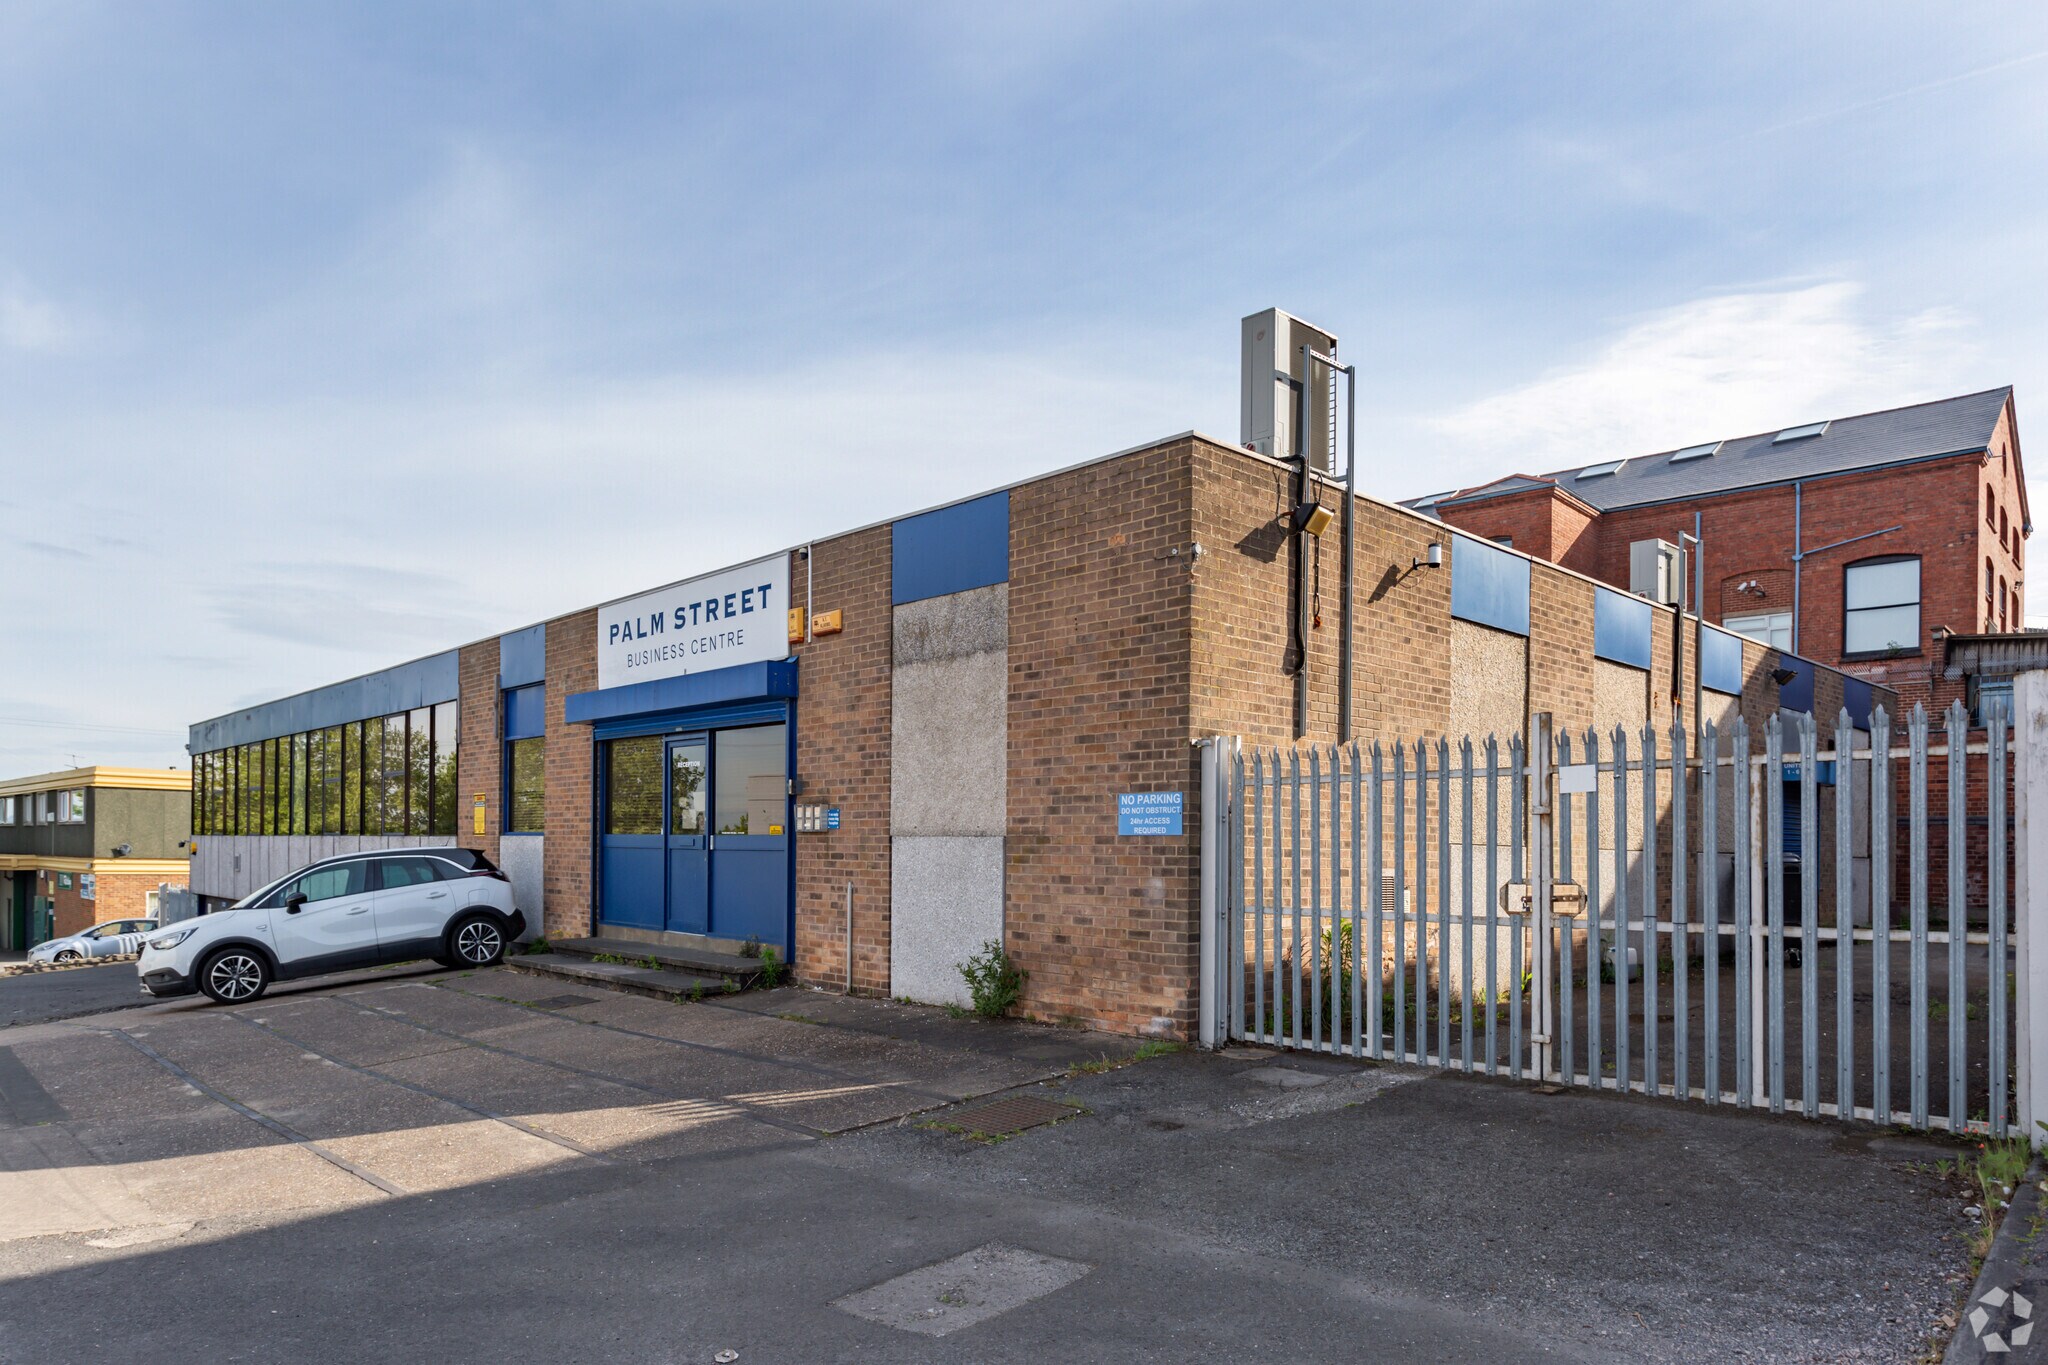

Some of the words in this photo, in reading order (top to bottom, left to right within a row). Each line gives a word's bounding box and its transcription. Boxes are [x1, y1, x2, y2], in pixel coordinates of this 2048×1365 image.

[610, 612, 664, 645] PALM
[674, 584, 772, 629] STREET
[628, 642, 685, 667] BUSINESS
[691, 629, 744, 655] CENTRE
[677, 760, 700, 768] RECEPTION
[1121, 795, 1135, 805] NO
[1137, 794, 1181, 804] PARKING
